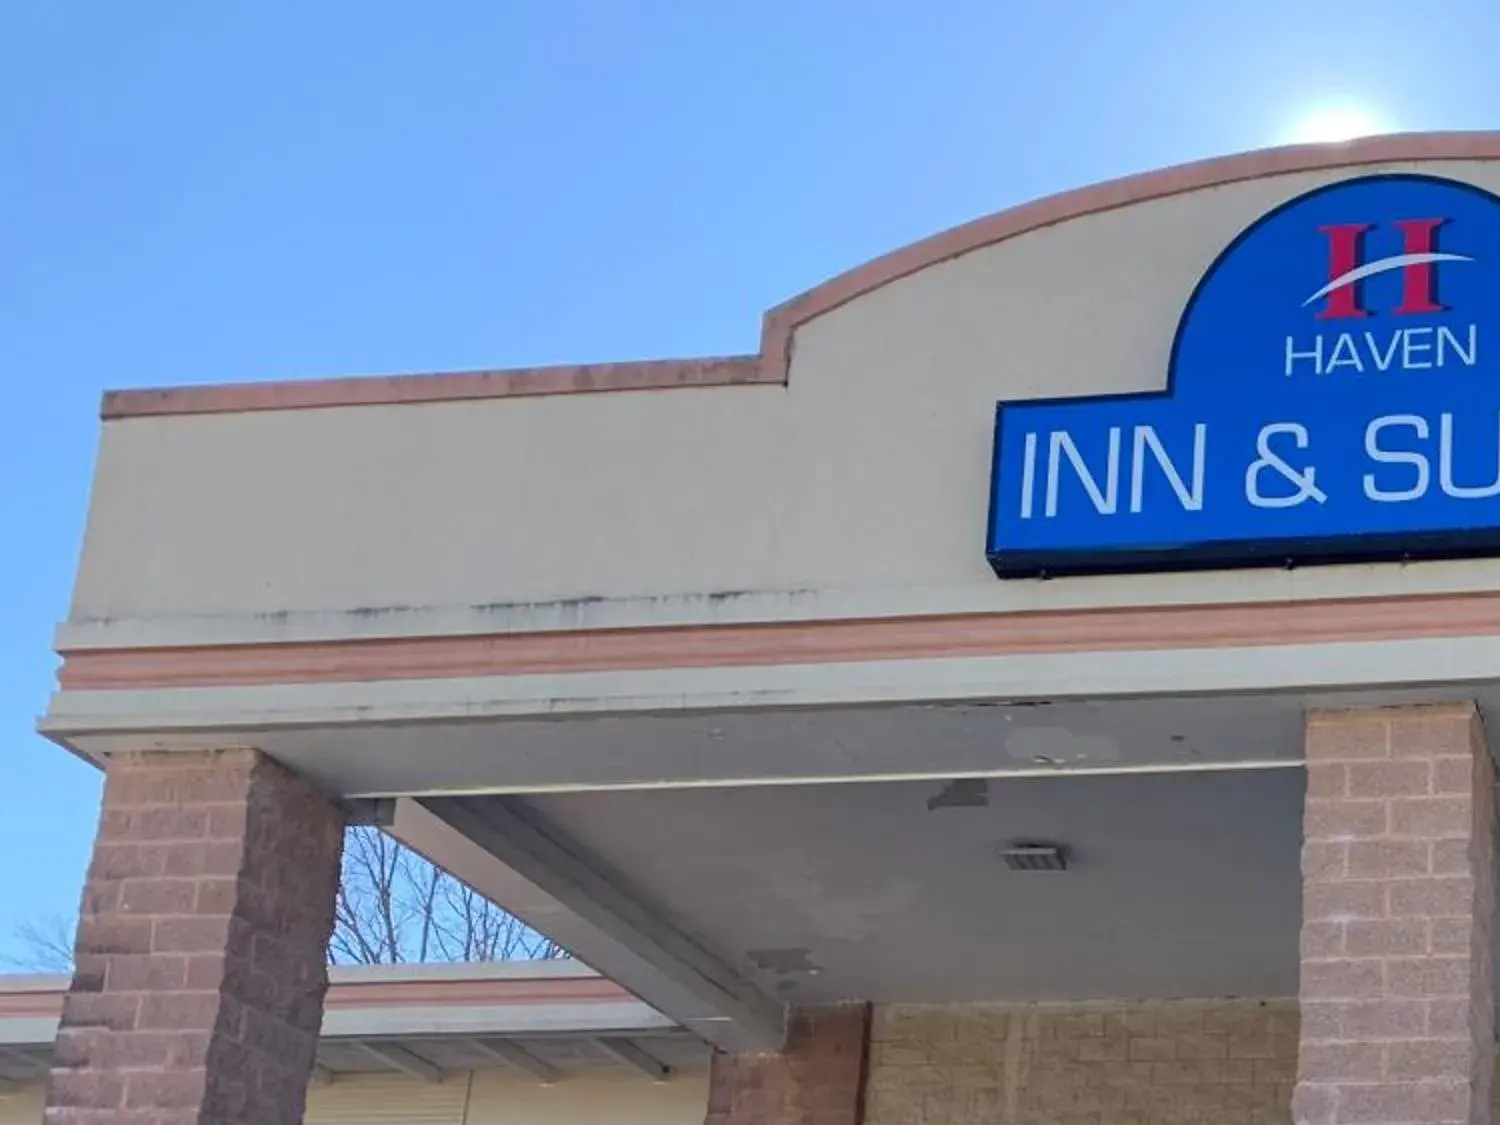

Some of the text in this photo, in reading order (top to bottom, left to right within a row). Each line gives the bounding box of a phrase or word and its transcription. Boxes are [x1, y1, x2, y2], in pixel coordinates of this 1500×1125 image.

[1285, 323, 1477, 377] HAVEN
[1020, 423, 1207, 519] INN
[1245, 421, 1329, 509] &
